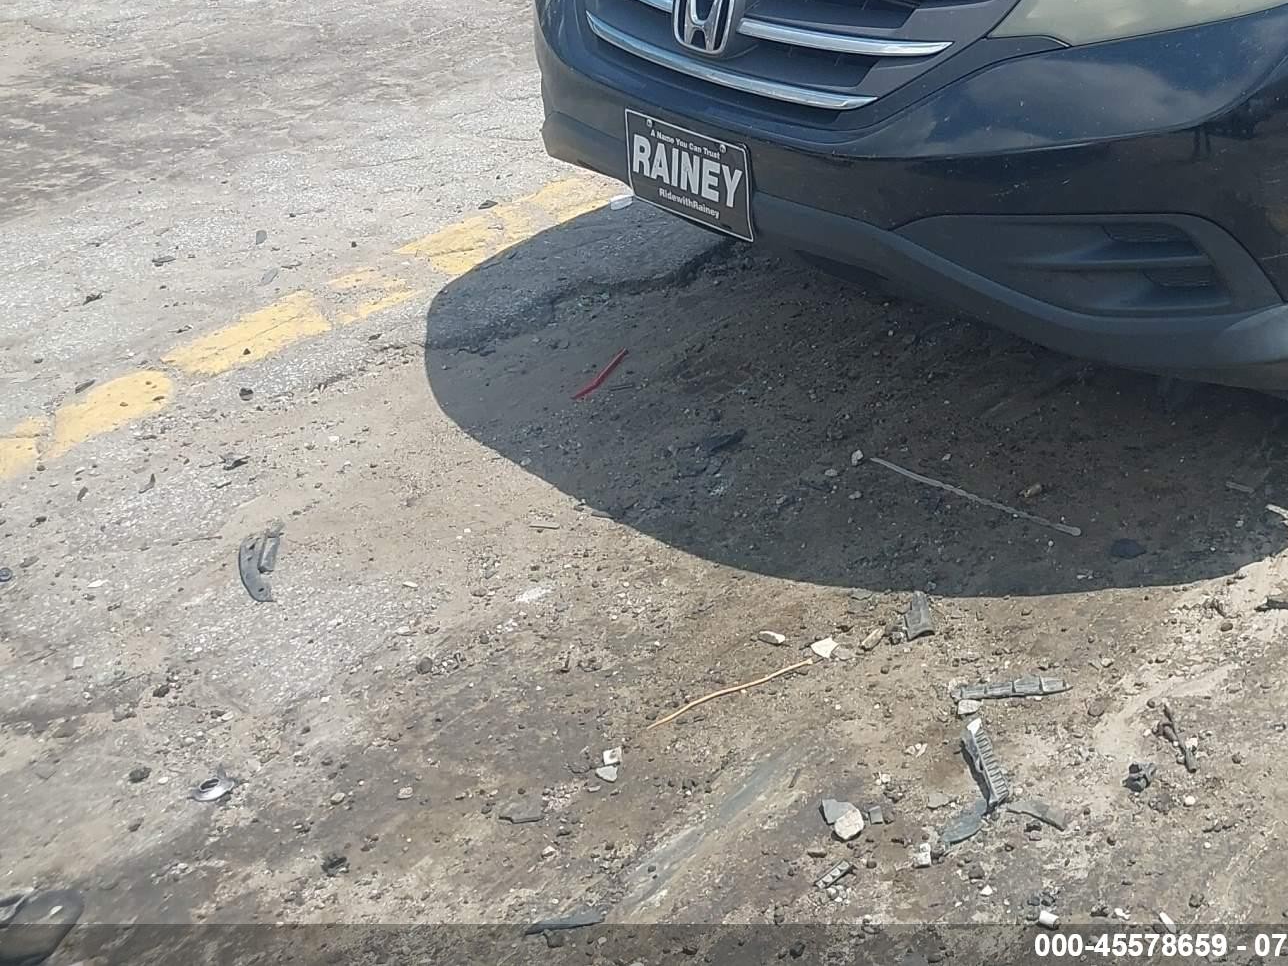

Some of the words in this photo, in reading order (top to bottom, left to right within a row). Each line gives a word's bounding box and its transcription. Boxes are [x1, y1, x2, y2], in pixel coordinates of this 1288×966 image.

[650, 129, 656, 137] A
[656, 131, 675, 144] Name
[675, 137, 688, 148] You
[689, 142, 702, 153] Can
[702, 147, 721, 159] Trust
[632, 134, 743, 208] RAINEY
